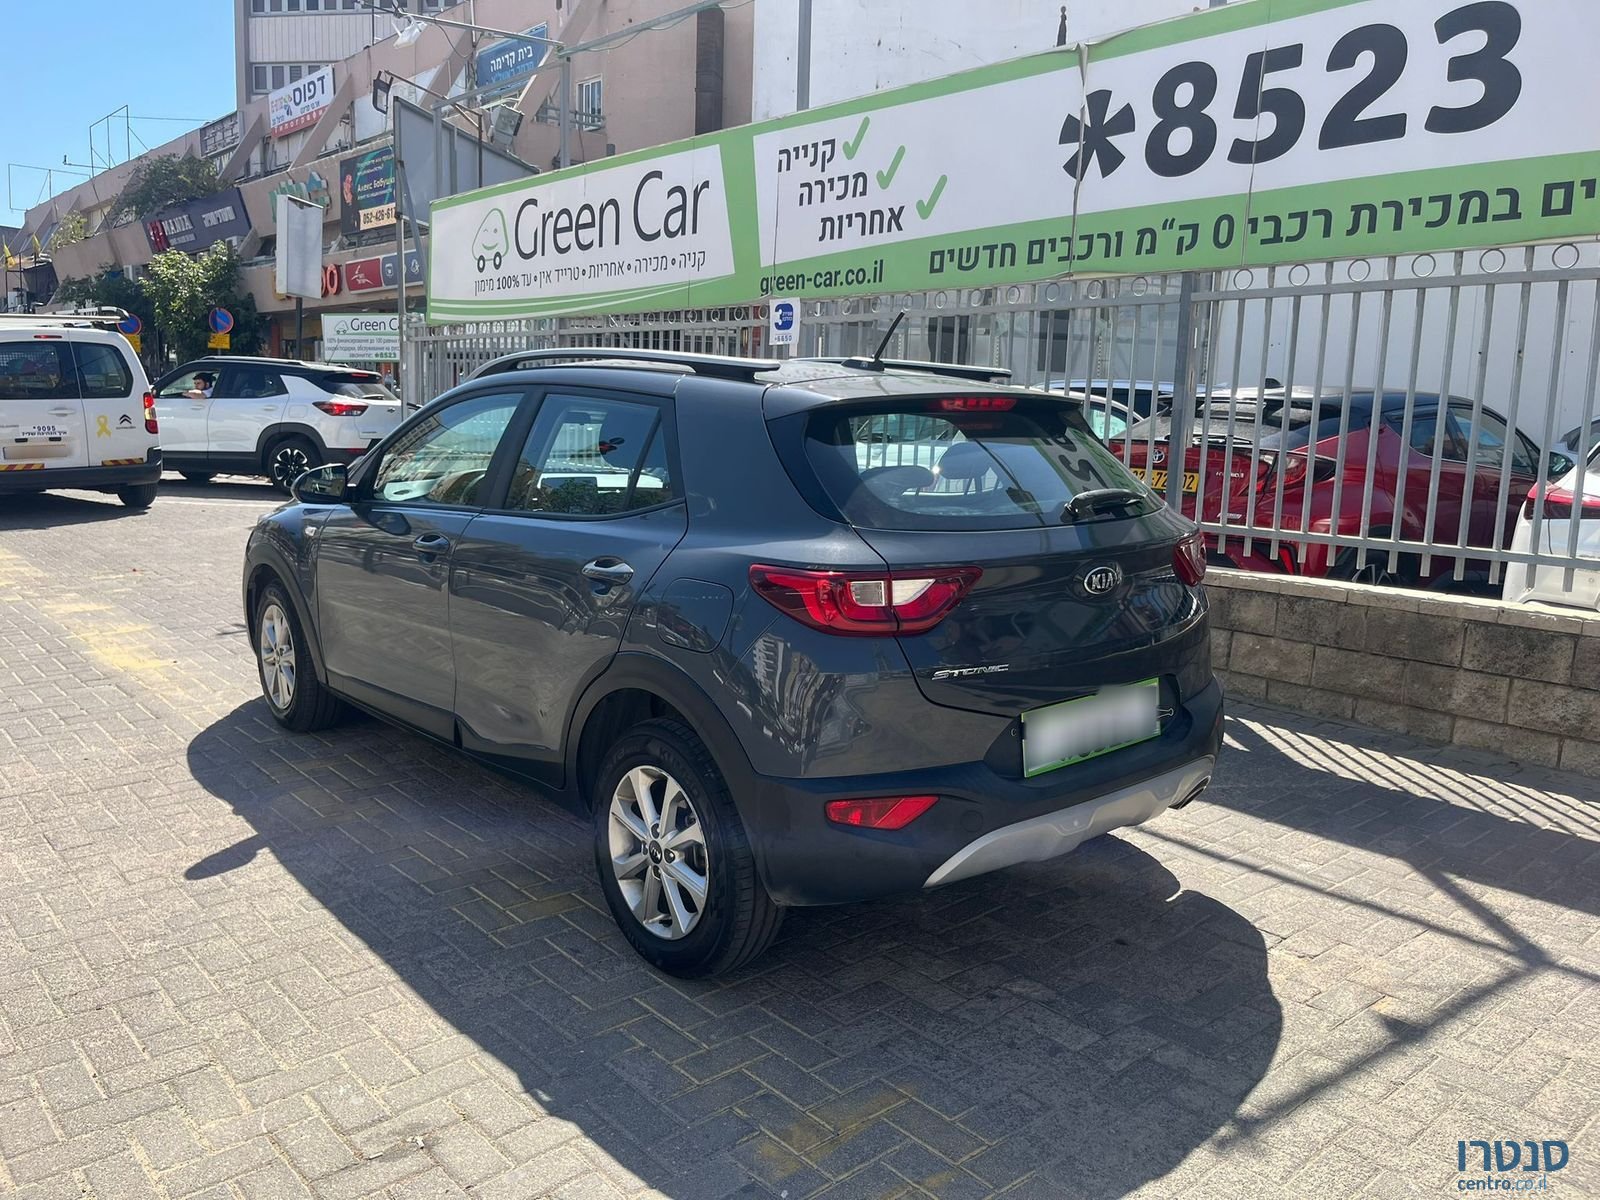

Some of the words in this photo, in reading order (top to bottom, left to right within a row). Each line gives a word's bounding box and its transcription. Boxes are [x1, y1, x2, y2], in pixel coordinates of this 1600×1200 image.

[518, 46, 533, 61] בית
[293, 75, 325, 106] דפוס
[778, 138, 836, 173] קנייה
[799, 171, 868, 207] מכירה
[515, 198, 620, 260] Green
[633, 170, 710, 242] Car
[1346, 187, 1522, 236] במכירת
[819, 205, 905, 242] אחריות
[1213, 213, 1235, 249] 0
[1248, 207, 1332, 245] רכבי
[929, 242, 1016, 274] חדשים
[1026, 230, 1124, 265] ורכבים
[588, 260, 624, 279] אחריות
[634, 257, 668, 274] מכירה
[679, 250, 706, 271] קניה
[497, 273, 520, 290] 100%
[521, 272, 532, 287] עד
[538, 271, 552, 288] אין
[554, 266, 580, 283] טרייד
[760, 259, 884, 297] green-car.co.il
[474, 277, 494, 296] מימון
[350, 318, 386, 331] Green
[1091, 573, 1113, 590] KIA
[932, 664, 1009, 680] STONIC
